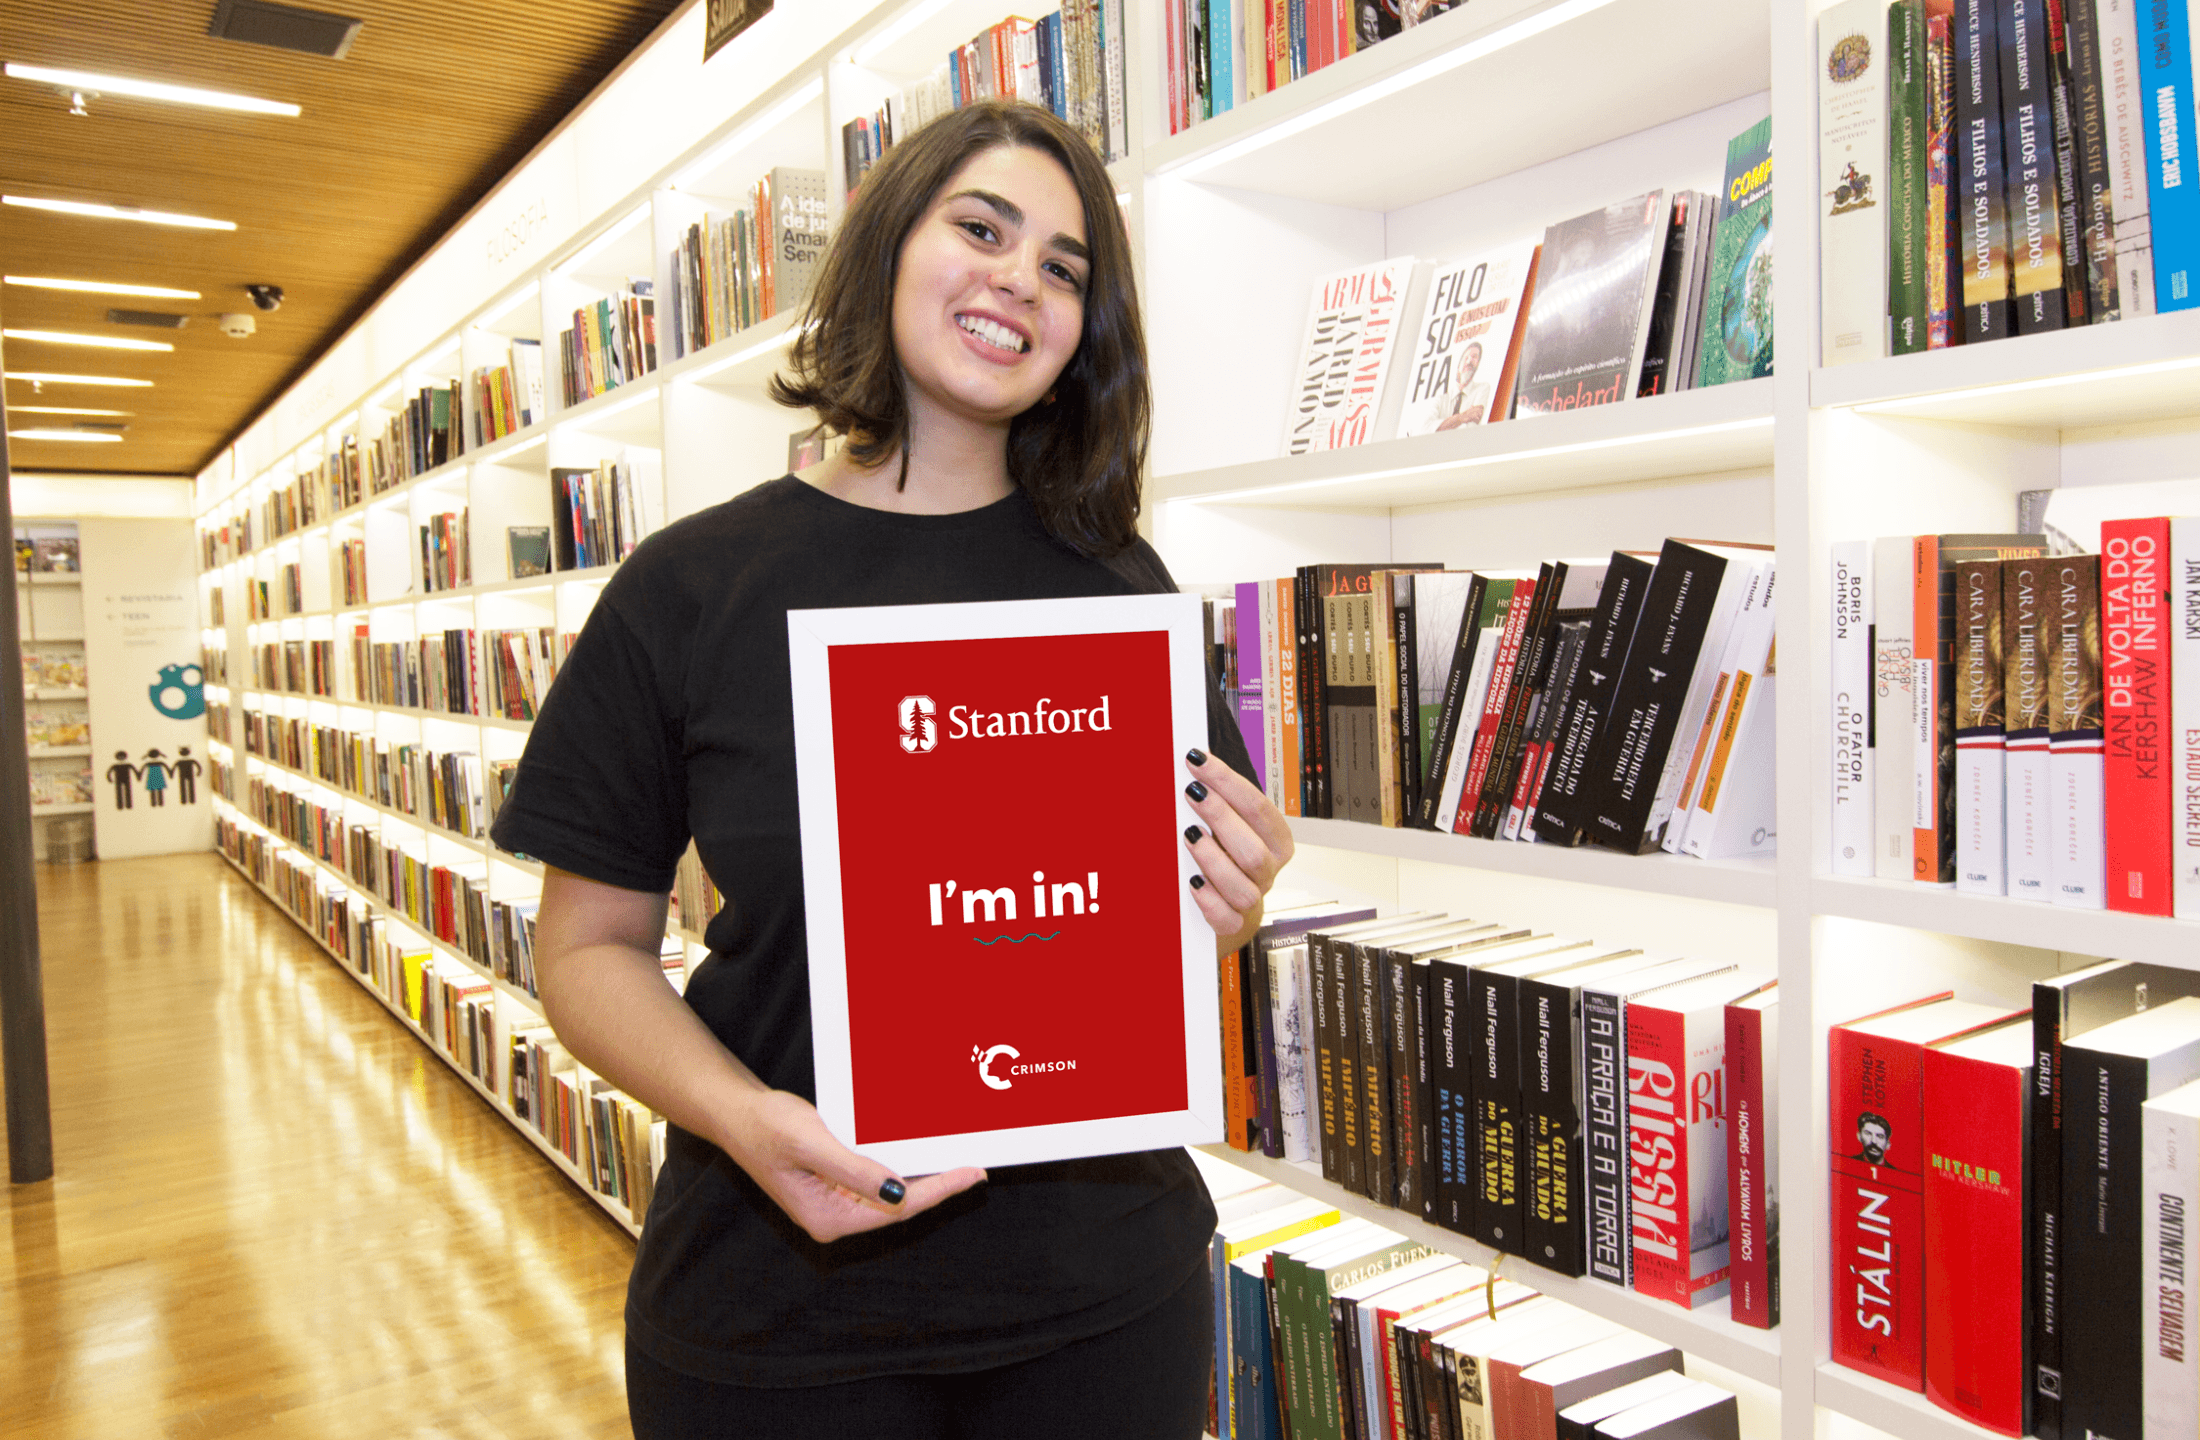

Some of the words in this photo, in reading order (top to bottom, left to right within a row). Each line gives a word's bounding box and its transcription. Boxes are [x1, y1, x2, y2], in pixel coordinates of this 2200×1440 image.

[1970, 34, 1982, 105] HENDERSON
[2015, 19, 2030, 91] HENDERSON
[1824, 118, 1877, 137] MANUSCRITOS
[1972, 118, 1987, 178] FILHOS
[2019, 104, 2036, 165] FILHOS
[2083, 84, 2102, 174] HISTÓRIAS
[2157, 85, 2180, 161] HOBSBAWM
[1974, 181, 1988, 193] E
[2024, 168, 2038, 181] E
[2118, 125, 2133, 200] AUSCHWITZ
[2162, 159, 2182, 189] ERIC
[487, 198, 548, 271] FILOSOFIA
[781, 211, 805, 229] de
[1974, 196, 1991, 280] SOLDADOS
[2024, 183, 2043, 269] SOLDADOS
[784, 245, 818, 263] Sen
[1432, 262, 1488, 316] FILO
[1322, 312, 1362, 409] JARED
[1422, 312, 1457, 359] SO
[1290, 315, 1339, 456] DIAMOND
[1412, 354, 1452, 404] FIA
[2106, 537, 2129, 578] DO
[2185, 559, 2200, 584] JAN
[1612, 577, 1629, 620] RICHARD
[1674, 570, 1693, 614] RICHARD
[1744, 575, 1759, 611] estudos
[1763, 571, 1776, 608] estudos
[1837, 561, 1848, 639] JOHNSON
[1850, 577, 1861, 623] BORIS
[1969, 572, 1984, 621] CARA
[2018, 570, 2034, 620] CARA
[2061, 568, 2077, 619] CARA
[2131, 536, 2157, 650] INFERNO
[1661, 625, 1676, 655] EVANS
[2108, 584, 2131, 669] VOLTA
[2186, 590, 2200, 640] KARSKI
[1282, 650, 1293, 671] 22
[1547, 640, 1565, 687] TERRORISTA
[1567, 640, 1585, 687] TERRORISTA
[1601, 629, 1614, 659] EVANS
[1878, 647, 1889, 698] GRANDE
[1900, 646, 1911, 693] ABISMO
[1969, 625, 1985, 720] LIBERDADE
[2019, 625, 2035, 720] LIBERDADE
[2062, 624, 2080, 721] LIBERDADE
[2109, 674, 2132, 708] DE
[948, 694, 1113, 741] Stanford
[1283, 675, 1295, 725] DIAS
[1401, 686, 1409, 736] HISTORIADOR
[1440, 708, 1451, 743] CONCISA
[1450, 670, 1460, 694] ITÁLIA
[1629, 709, 1643, 730] EM
[1851, 713, 1862, 725] O
[2135, 657, 2158, 779] KERSHAW
[1564, 699, 1588, 755] TERCEIRO
[1571, 717, 1595, 774] CHEGADA
[1634, 702, 1660, 762] TERCEIRO
[1723, 711, 1736, 742] sentido
[1837, 692, 1849, 805] CHURCHILL
[2111, 714, 2132, 757] IAN
[1552, 755, 1571, 792] REICH
[1612, 731, 1636, 782] GUERRA
[1851, 731, 1862, 783] FATOR
[2186, 729, 2200, 781] ESTADO
[1565, 776, 1578, 795] DO
[1621, 761, 1642, 801] REICH
[2186, 785, 2200, 847] SECRETO
[1032, 870, 1101, 919] in!
[1272, 935, 1297, 949] HISTÓRIA
[1315, 945, 1324, 971] Niall
[1336, 953, 1345, 980] Niall
[1362, 958, 1372, 986] Niall
[1393, 964, 1404, 993] Niall
[1443, 977, 1454, 1007] Niall
[1316, 973, 1326, 1028] Ferguson
[1336, 982, 1347, 1037] Ferguson
[1362, 988, 1373, 1045] Ferguson
[1394, 995, 1405, 1052] Ferguson
[1486, 985, 1498, 1017] Niall
[1538, 996, 1550, 1029] Niall
[1585, 1004, 1617, 1016] FERGUSON
[1228, 999, 1239, 1062] CATARINA
[1443, 1009, 1454, 1068] Ferguson
[1486, 1018, 1498, 1079] Ferguson
[1591, 1018, 1613, 1037] A
[1629, 1023, 1644, 1031] UMA
[1629, 1030, 1660, 1041] HISTÓRIA
[1629, 1037, 1662, 1049] CULTURAL
[1010, 1059, 1077, 1077] CRIMSON
[1537, 1029, 1550, 1093] Ferguson
[1591, 1042, 1615, 1127] PRAÇA
[1862, 1049, 1873, 1106] STEPHEN
[1874, 1059, 1886, 1109] KOTKIN
[2037, 1051, 2051, 1096] IGREJA
[1321, 1048, 1336, 1135] IMPÉRIO
[1341, 1058, 1357, 1147] IMPÉRIO
[1366, 1065, 1383, 1156] IMPÉRIO
[1440, 1088, 1449, 1110] DA
[1454, 1093, 1464, 1107] O
[1488, 1101, 1496, 1120] DO
[2098, 1067, 2109, 1113] ANTIGO
[1441, 1116, 1452, 1183] GUERRA
[1455, 1111, 1467, 1185] HORROR
[1539, 1115, 1549, 1136] DO
[1594, 1131, 1616, 1151] E
[1738, 1110, 1750, 1155] HOMENS
[2098, 1117, 2109, 1170] ORIENTE
[1485, 1126, 1499, 1203] MUNDO
[1500, 1121, 1515, 1206] GUERRA
[1552, 1136, 1568, 1224] GUERRA
[1594, 1155, 1616, 1175] A
[1628, 1055, 1686, 1261] RÚSSIA
[1932, 1153, 2001, 1185] HITLER
[2167, 1140, 2176, 1170] LOWE
[1536, 1140, 1551, 1221] MUNDO
[1740, 1168, 1751, 1220] SALVAVAM
[1595, 1183, 1618, 1265] TORRE
[1741, 1222, 1753, 1262] LIVROS
[2045, 1212, 2055, 1267] MICHAEL
[2159, 1192, 2185, 1287] CONTINENTE
[1330, 1258, 1385, 1292] CARLOS
[1635, 1253, 1686, 1276] ORLANDO
[1636, 1265, 1664, 1280] FIGES
[1849, 1187, 1892, 1337] STÁLIN
[1384, 1318, 1394, 1339] UMA
[2045, 1272, 2055, 1335] KERRIGAN
[2159, 1285, 2185, 1363] SELVAGEM
[1387, 1340, 1400, 1389] PRODUÇÃO
